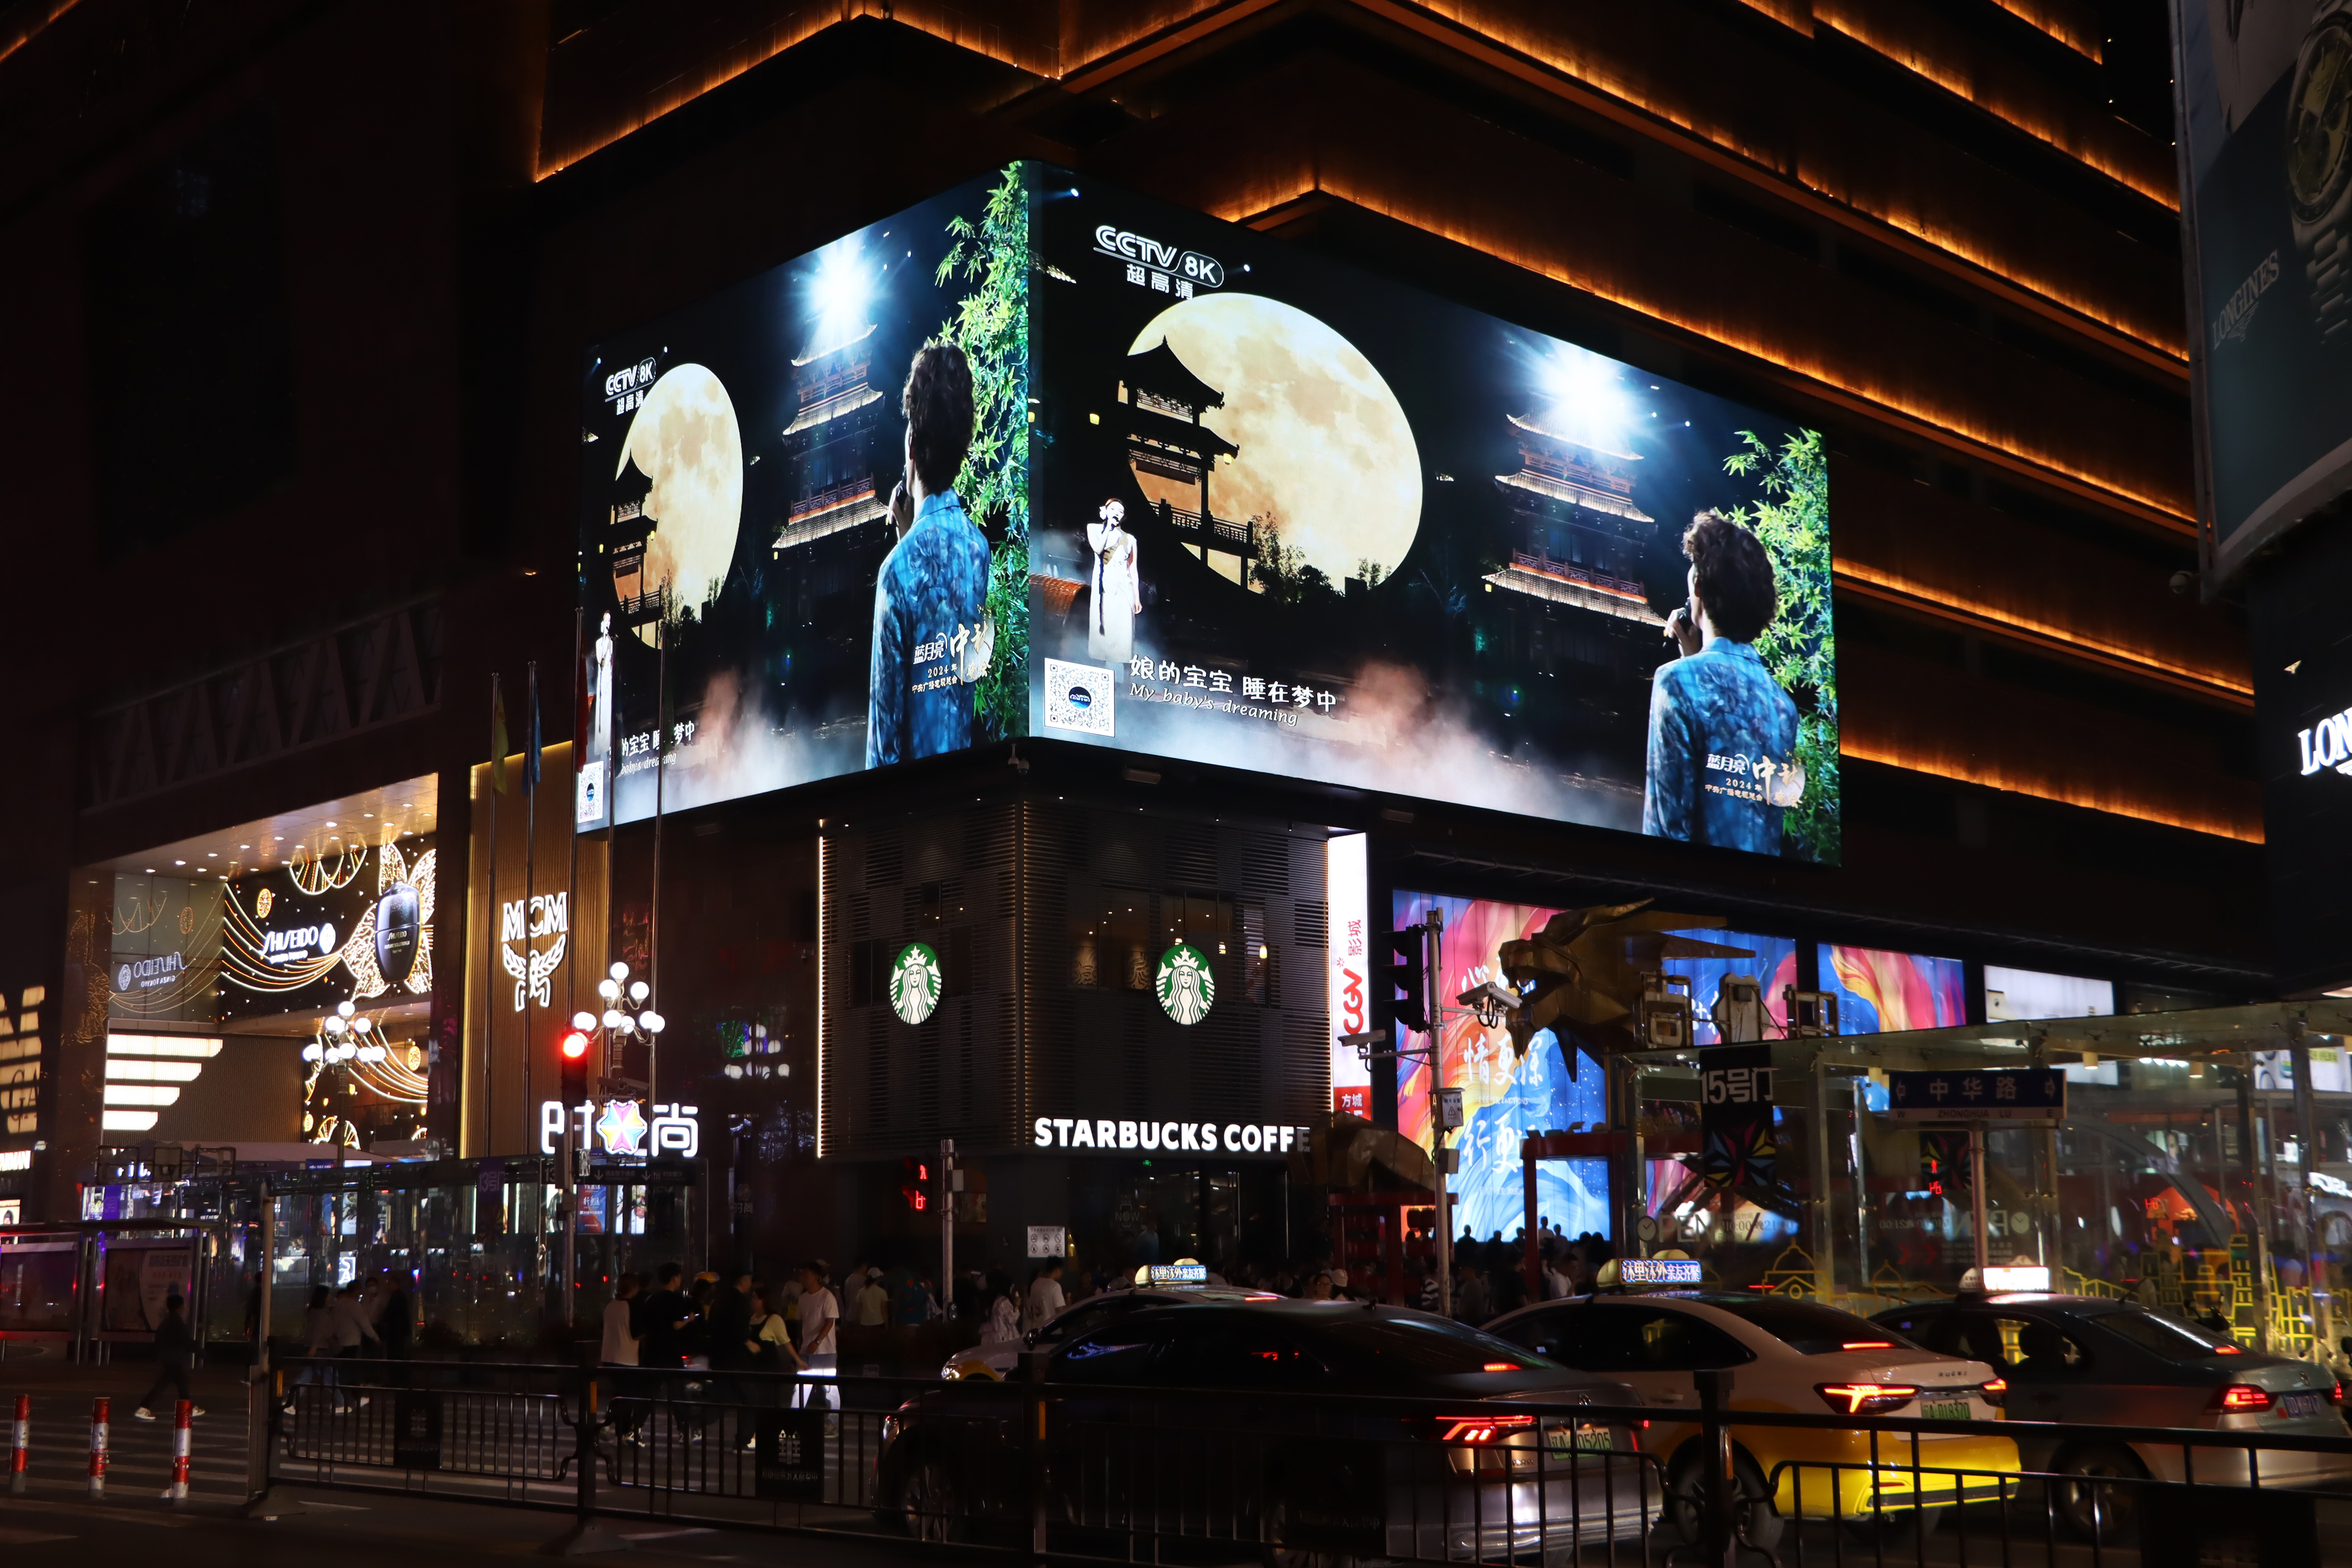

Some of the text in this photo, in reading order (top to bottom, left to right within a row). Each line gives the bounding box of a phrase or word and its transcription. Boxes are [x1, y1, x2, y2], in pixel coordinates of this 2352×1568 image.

[1096, 225, 1217, 284] CCTV 8K
[1126, 264, 1193, 300] 超高清
[2213, 249, 2279, 350] LONGINES
[606, 361, 653, 396] CCTV 8K
[617, 390, 643, 416] 超高清
[913, 633, 947, 665] 蓝月亮
[1129, 654, 1337, 712] 娘的宝宝 睡在梦中
[1129, 682, 1298, 727] My baby's dreaming
[620, 732, 649, 757] 的宝宝
[1706, 753, 1750, 775] 蓝月亮
[501, 892, 568, 942] MCM
[261, 925, 319, 955] SHISEIDO
[387, 930, 407, 941] SHISEIDO
[1348, 919, 1362, 956] 影城
[1342, 968, 1364, 1035] CGV
[1341, 1093, 1363, 1108] 方城
[1700, 1067, 1773, 1104] 15号门
[1929, 1077, 2017, 1103] 中华路
[1897, 1109, 2053, 1119] W ZHONGHUA LU E
[1034, 1117, 1217, 1151] STARBUCKS
